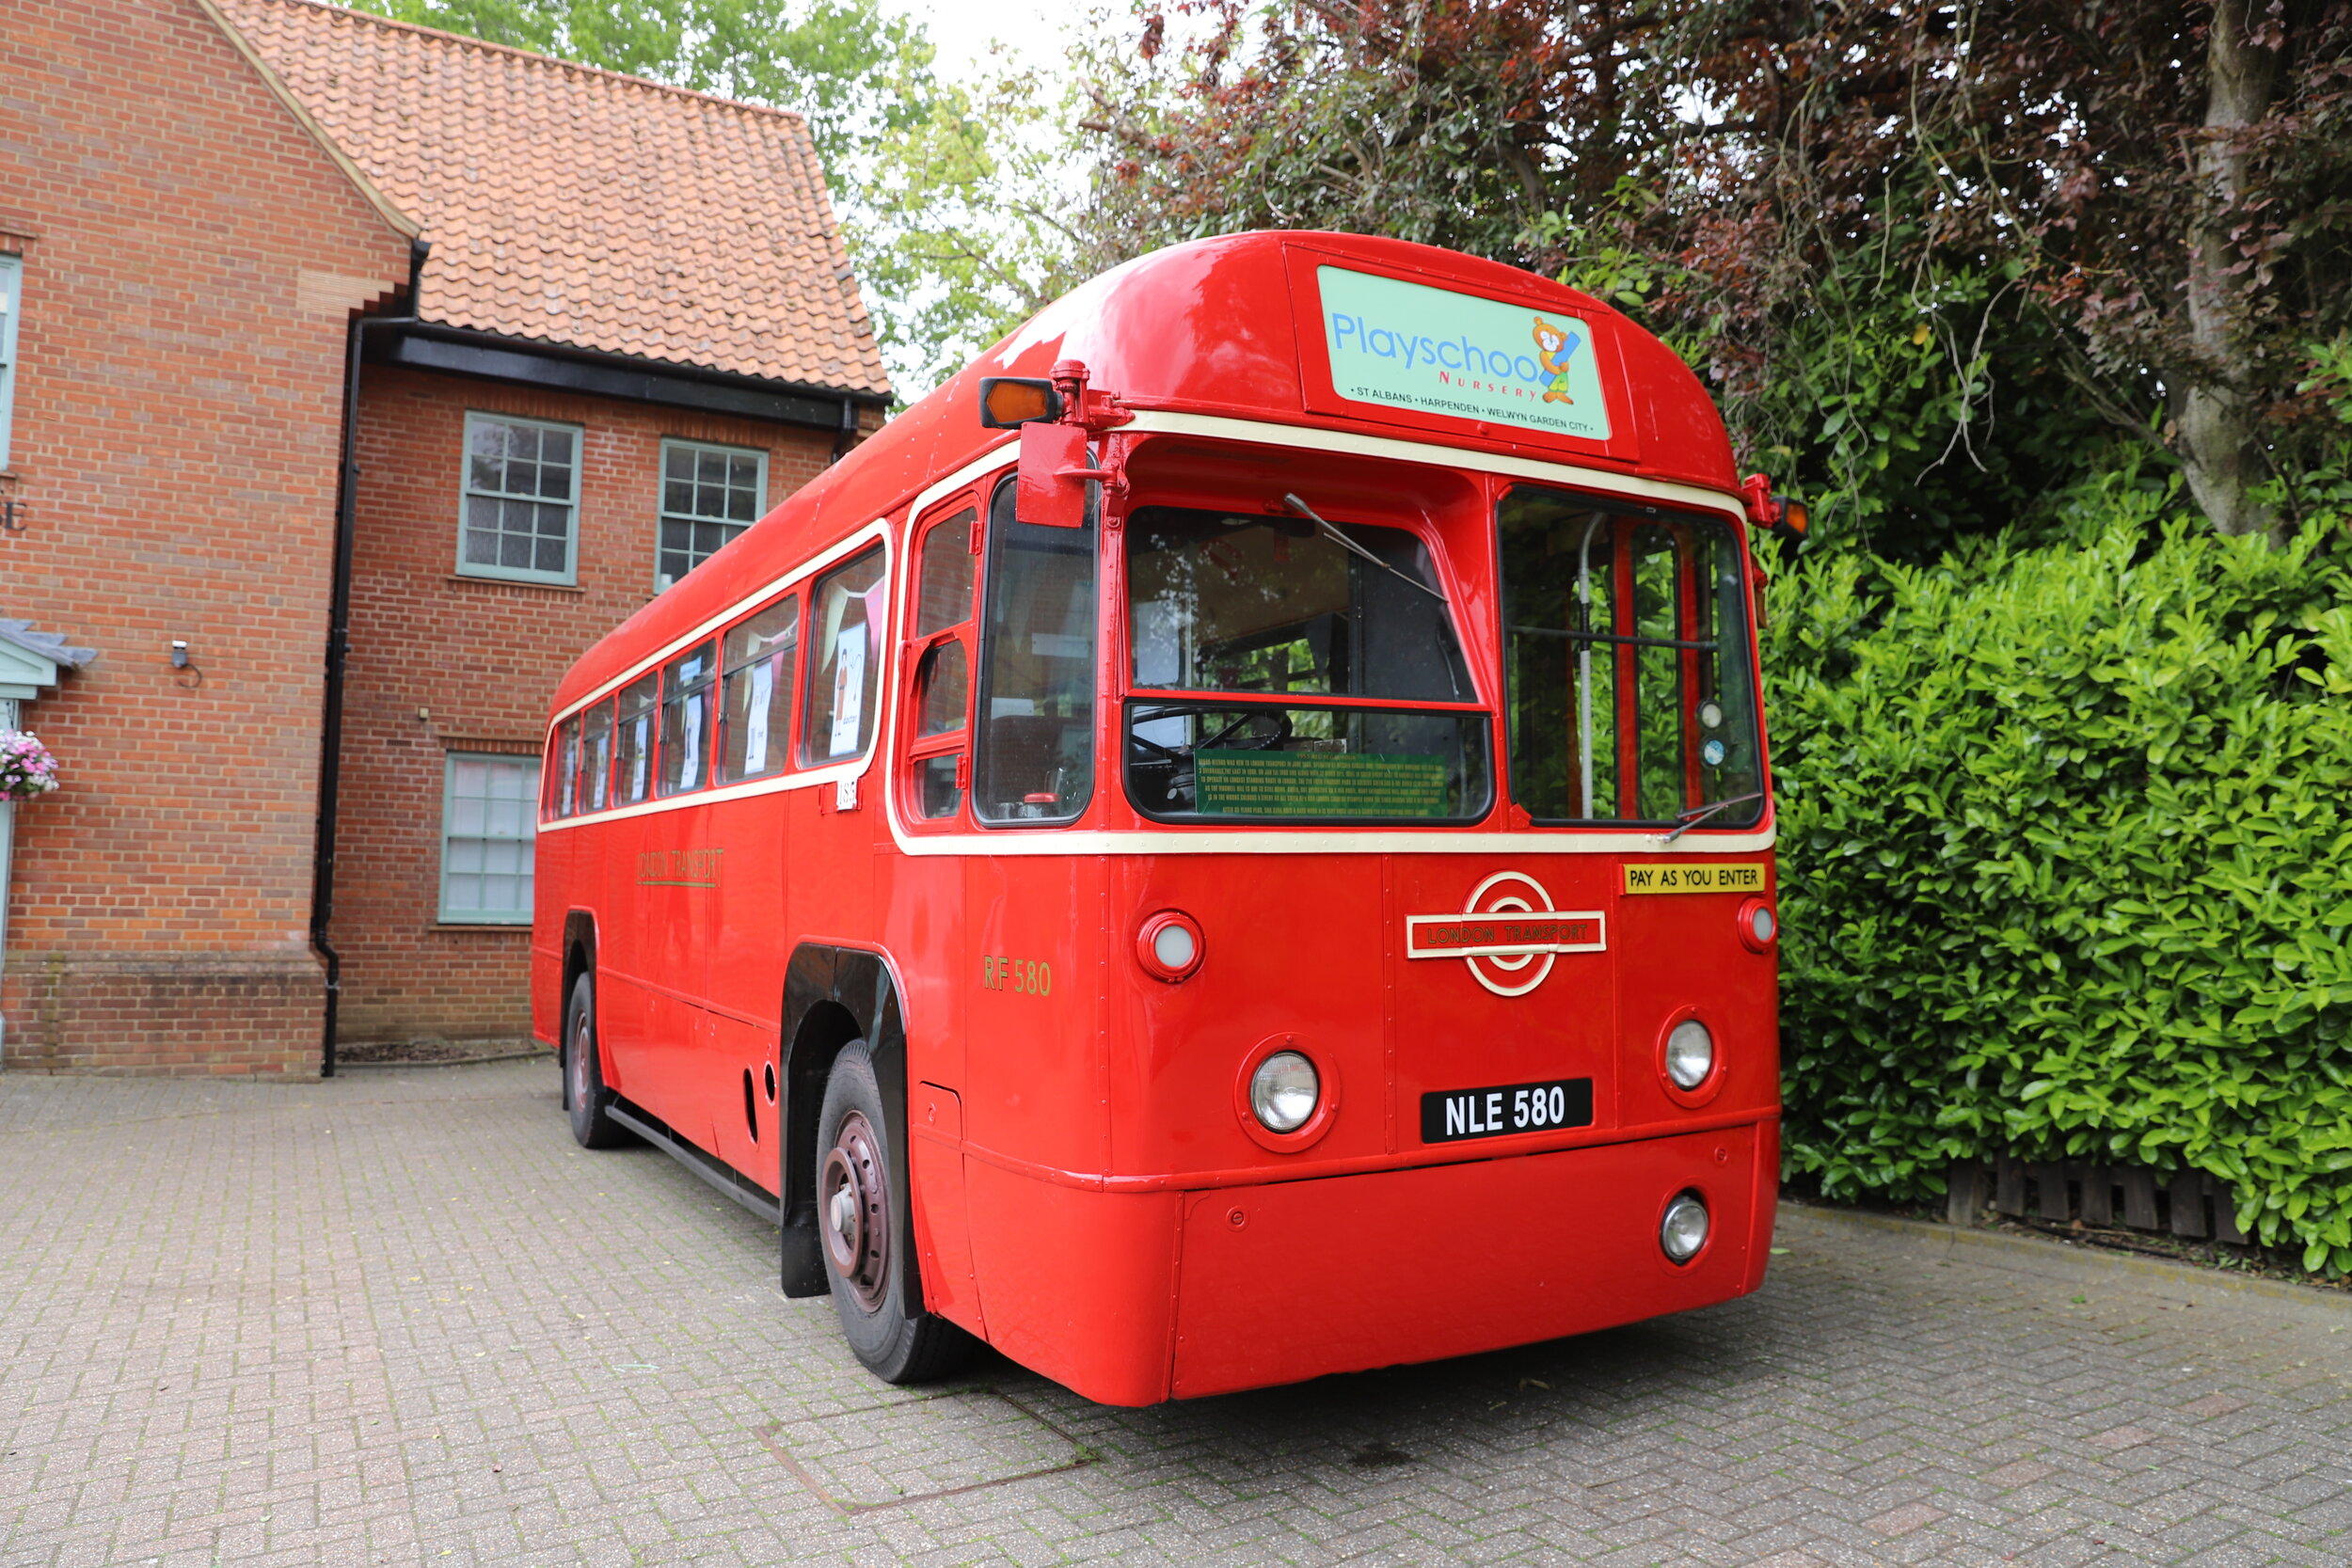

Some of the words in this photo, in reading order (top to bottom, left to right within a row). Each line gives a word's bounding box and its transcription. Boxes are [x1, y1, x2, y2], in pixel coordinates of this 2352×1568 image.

[1357, 387, 1371, 398] ST
[1372, 389, 1412, 404] ALBANS
[1421, 397, 1480, 414] HARPENDEN
[1486, 407, 1528, 422] WELWYN
[1530, 414, 1566, 428] GARDEN
[1568, 420, 1588, 432] CITY
[0, 501, 27, 531] E
[1629, 871, 1653, 887] PAY
[1661, 871, 1677, 886] AS
[1684, 870, 1712, 886] YOU
[1718, 869, 1758, 886] ENTER
[1427, 926, 1495, 944] LONDON
[1504, 924, 1588, 942] TRANSPORT
[984, 955, 1009, 991] RF
[1014, 958, 1051, 997] 580
[1446, 1092, 1503, 1136] NLE
[1514, 1085, 1565, 1129] 580
